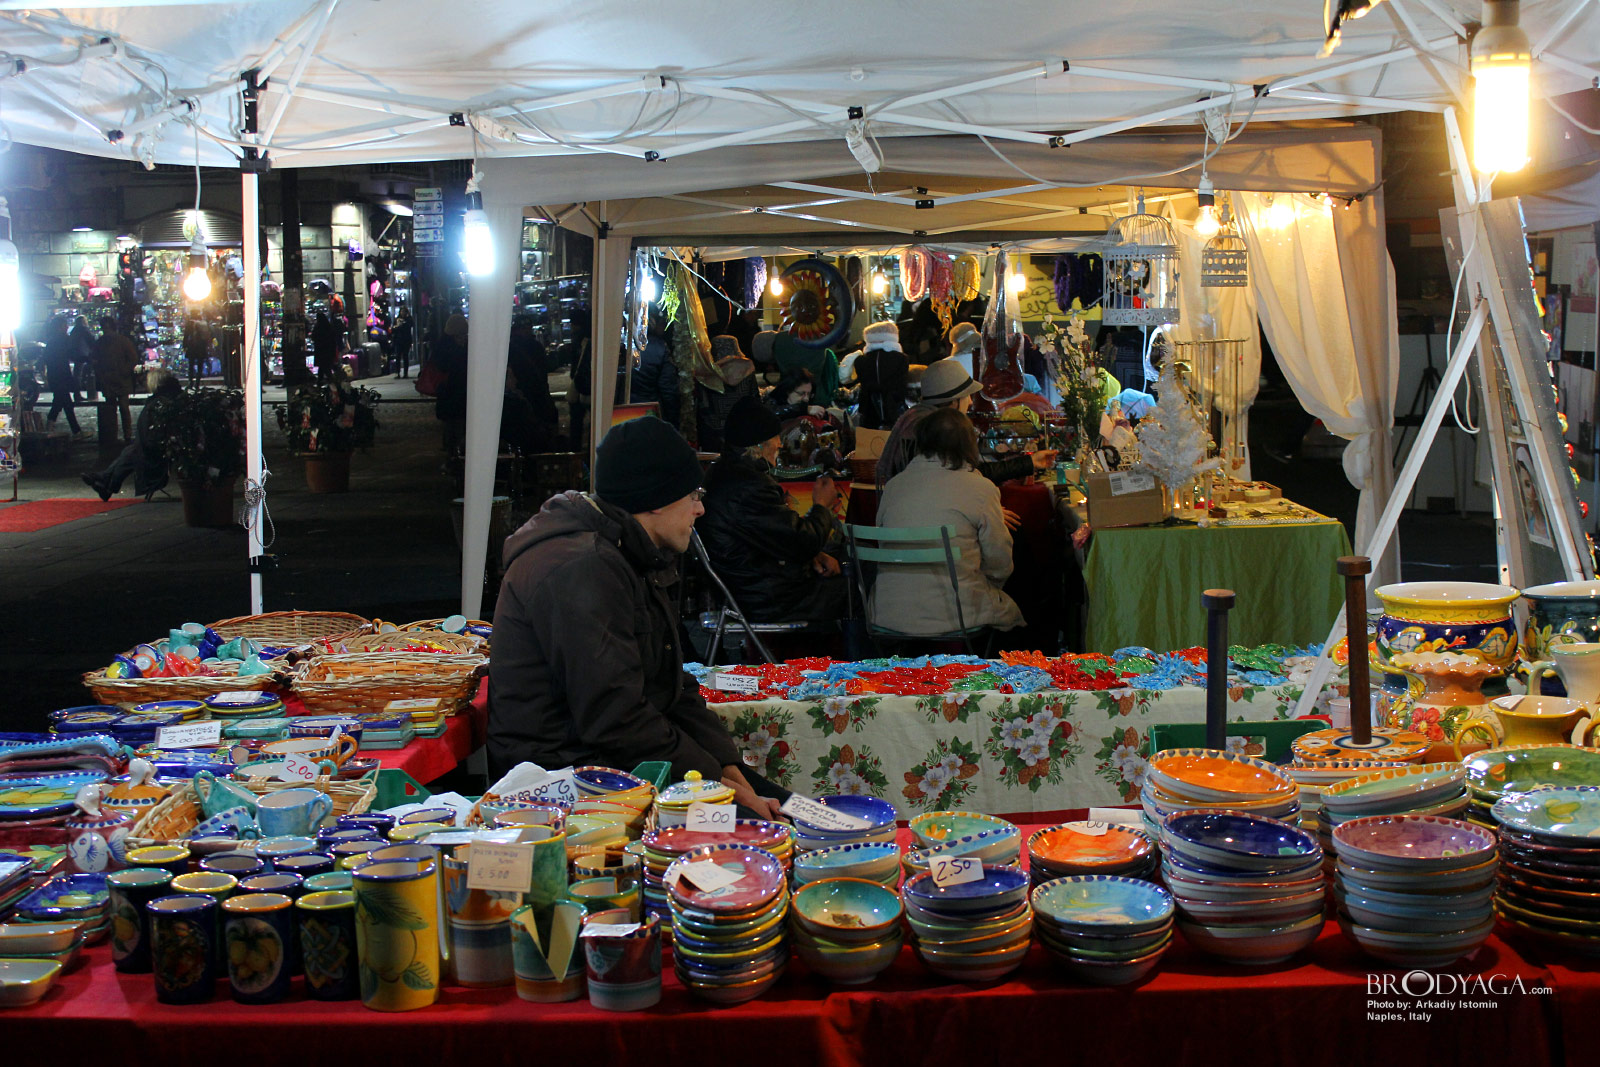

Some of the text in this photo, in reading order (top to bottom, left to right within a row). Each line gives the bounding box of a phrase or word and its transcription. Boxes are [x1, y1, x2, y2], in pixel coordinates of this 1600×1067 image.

[286, 759, 314, 780] 2.00
[533, 778, 570, 797] 2.00
[695, 808, 730, 824] 3.00
[936, 858, 972, 882] 2.50
